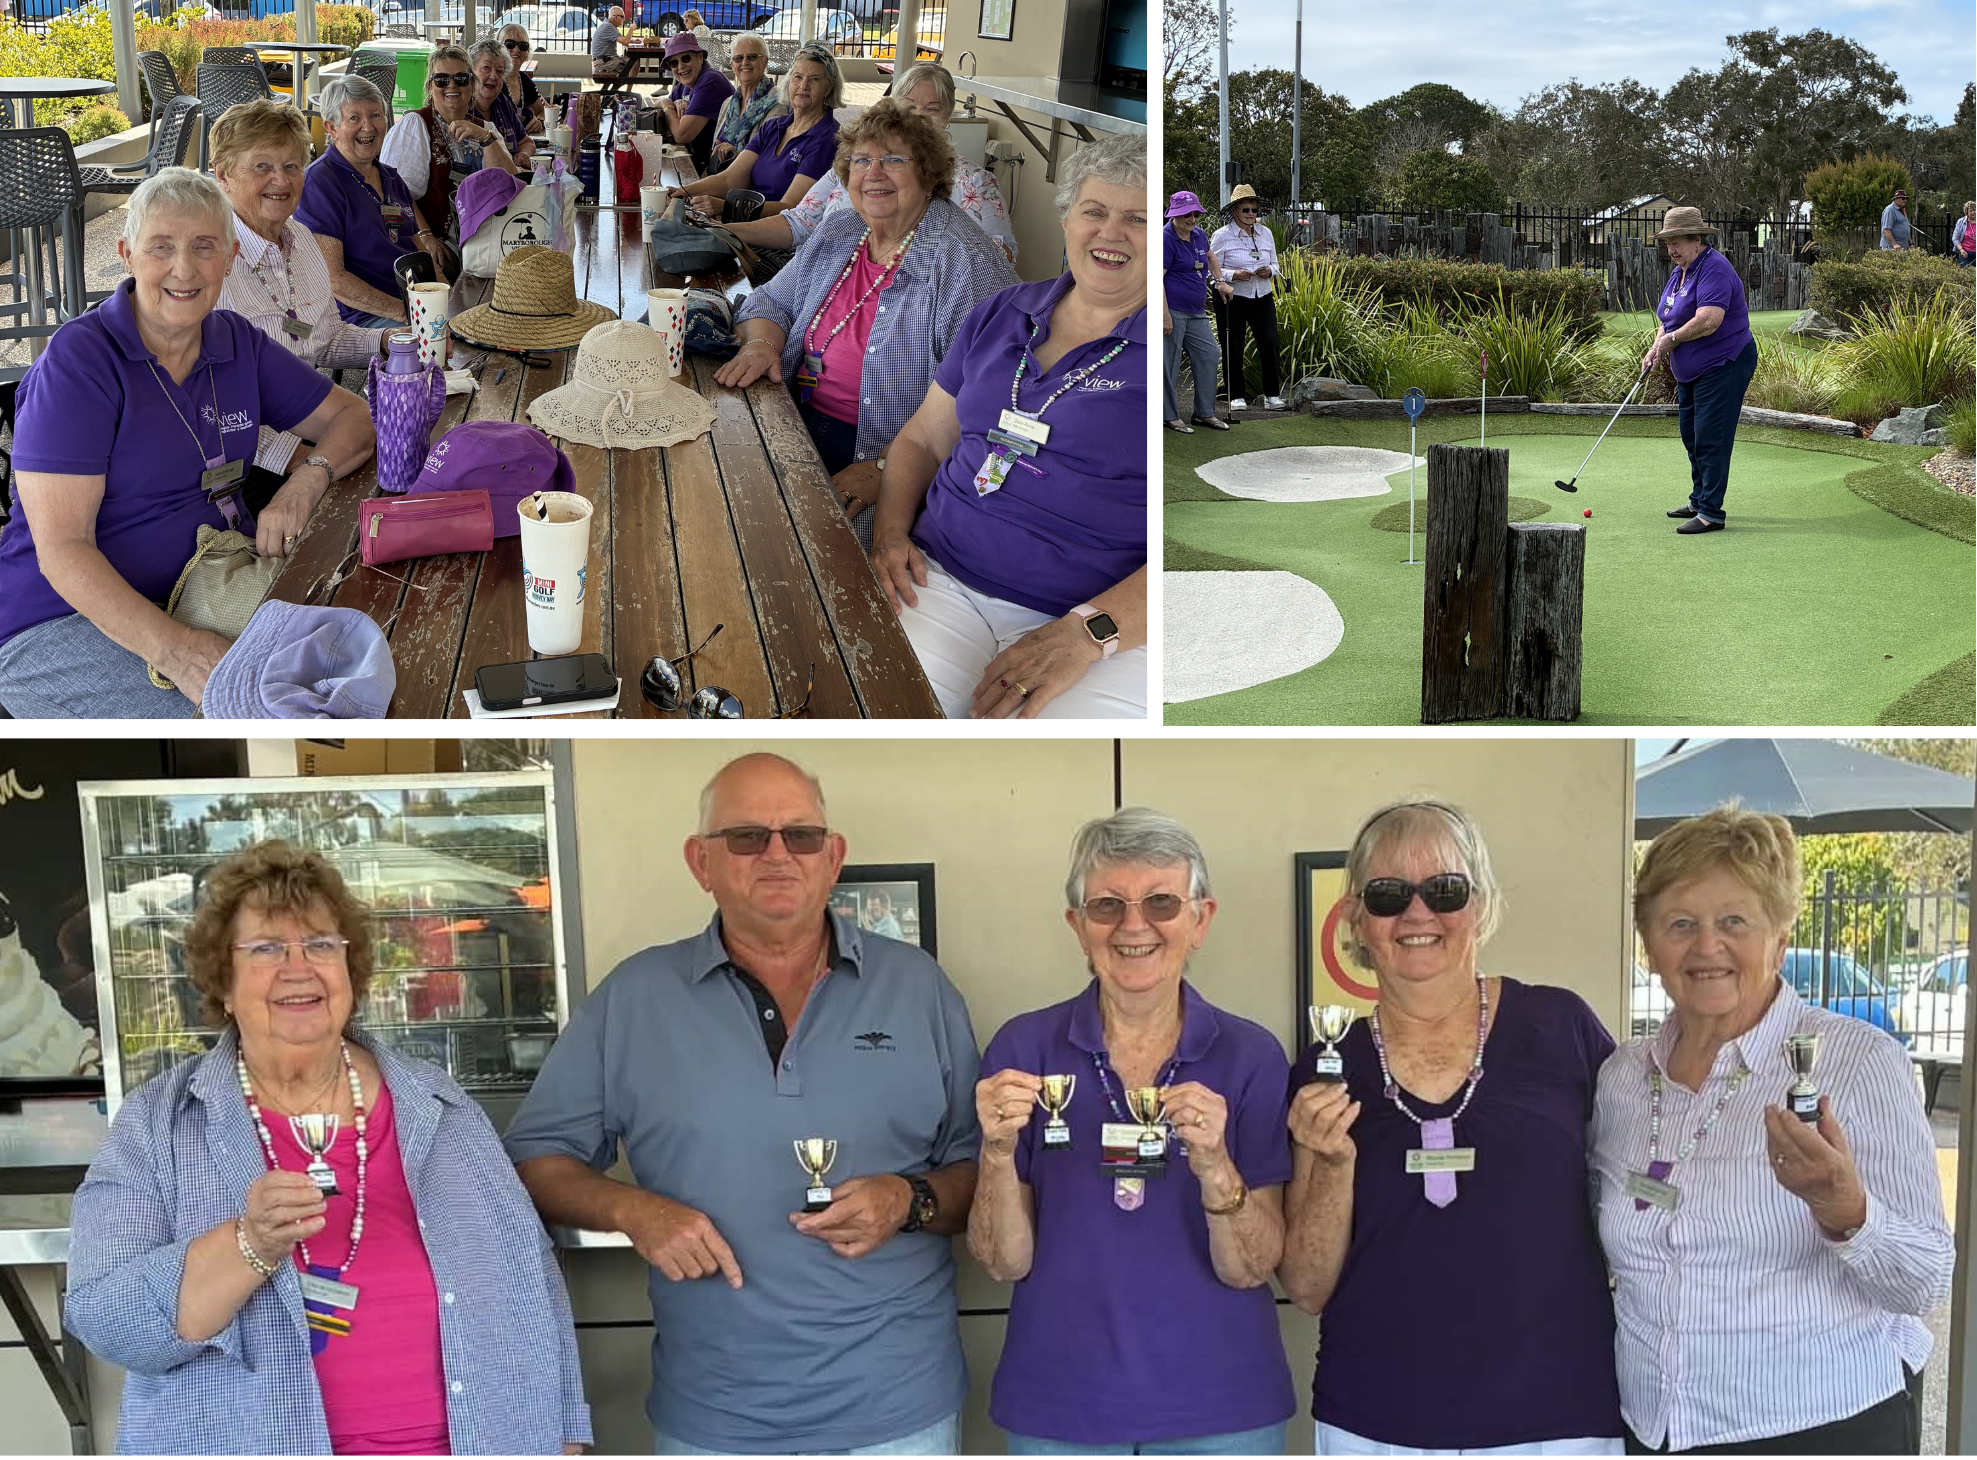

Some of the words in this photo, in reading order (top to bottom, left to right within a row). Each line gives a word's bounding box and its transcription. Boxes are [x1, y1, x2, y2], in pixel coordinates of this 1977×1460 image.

[1085, 374, 1126, 388] view
[1412, 397, 1416, 410] 1
[217, 410, 248, 426] view
[533, 585, 555, 596] GOLF
